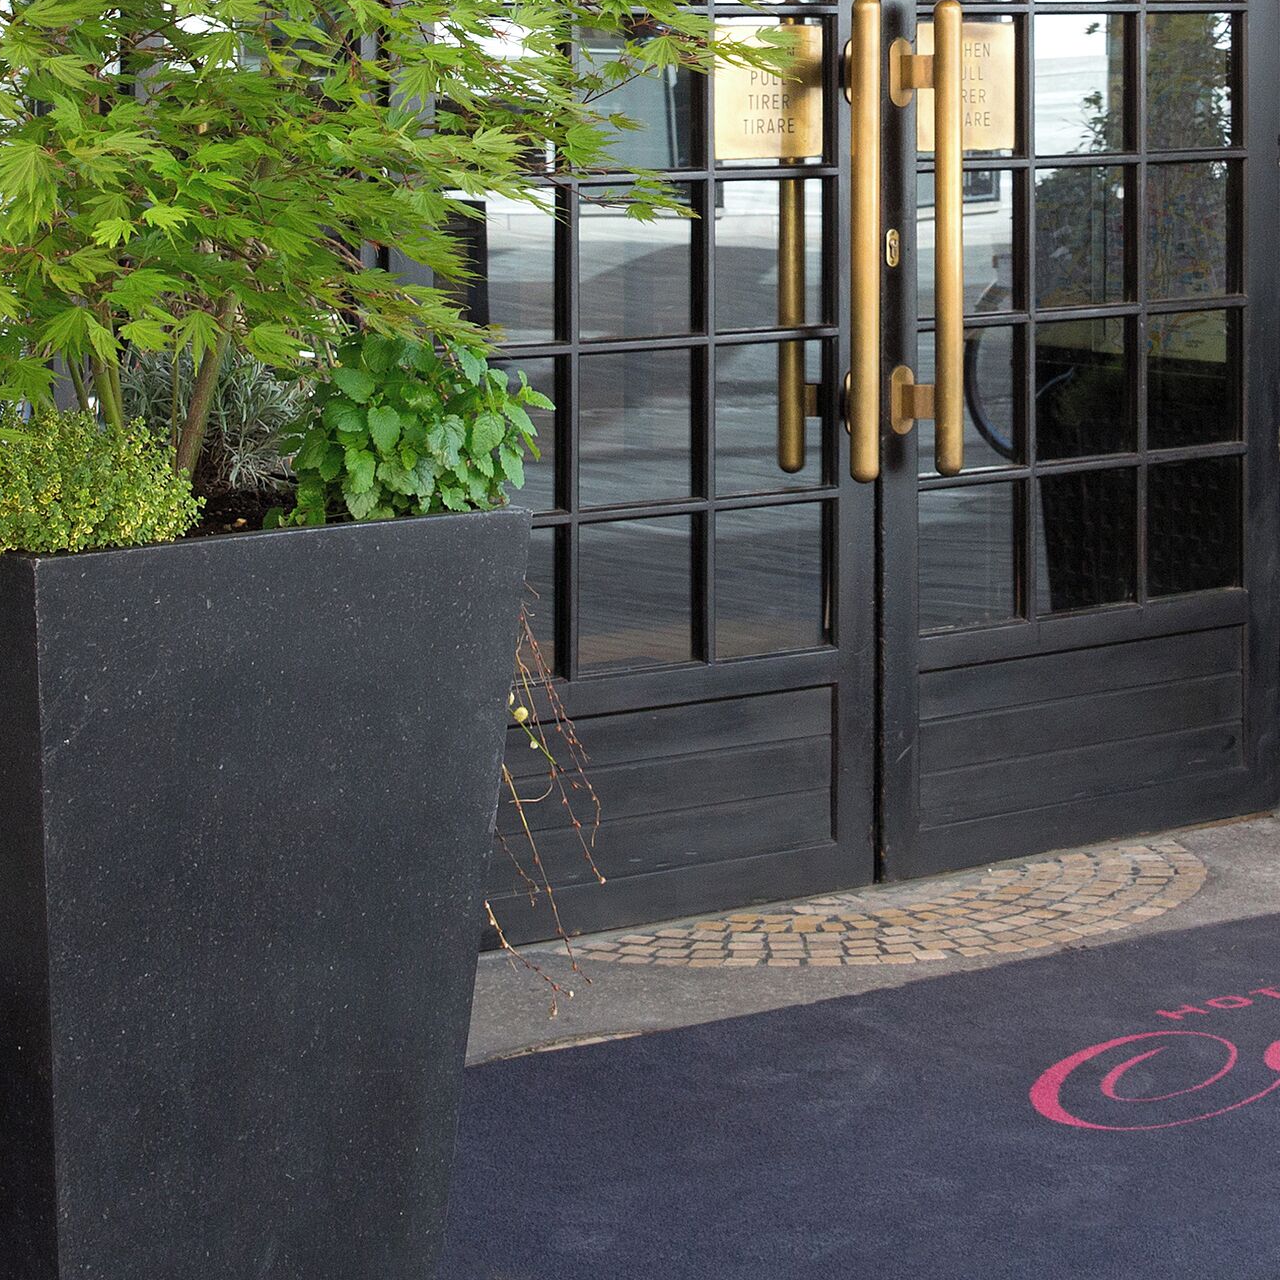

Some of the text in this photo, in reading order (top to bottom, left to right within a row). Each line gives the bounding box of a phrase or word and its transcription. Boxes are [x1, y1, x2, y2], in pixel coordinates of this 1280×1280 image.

[964, 43, 991, 58] HEN
[750, 69, 787, 86] PULL
[962, 66, 984, 81] ULL
[748, 94, 790, 110] TIRER
[962, 88, 987, 104] RER
[743, 118, 795, 134] TIRARE
[964, 111, 991, 127] ARE
